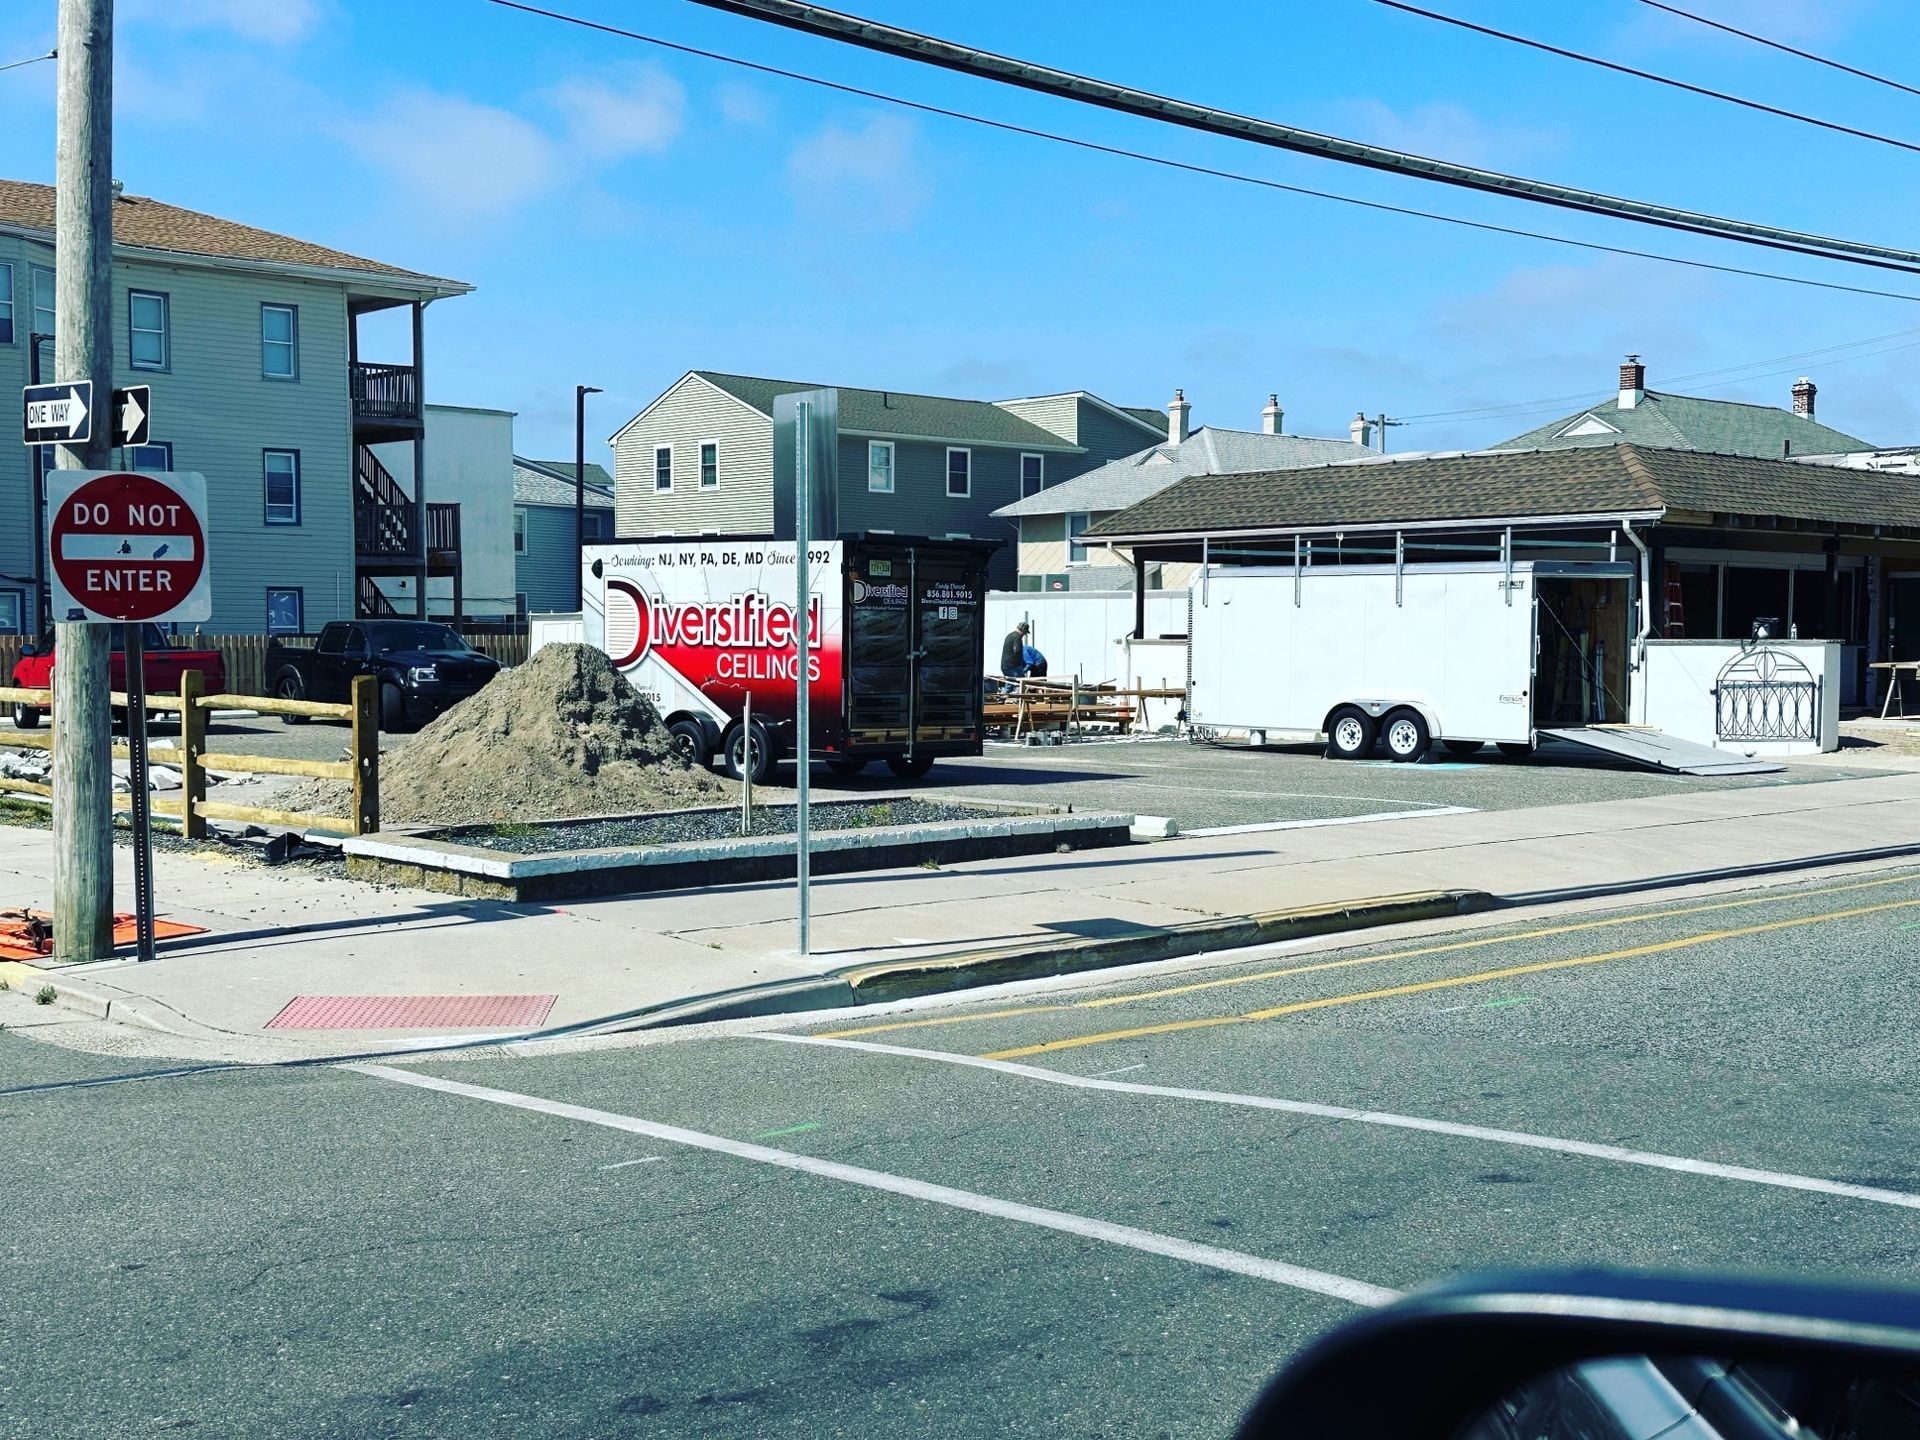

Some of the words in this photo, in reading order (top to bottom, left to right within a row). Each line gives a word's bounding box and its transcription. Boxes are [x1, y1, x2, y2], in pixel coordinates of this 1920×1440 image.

[29, 404, 46, 424] ONE
[51, 402, 70, 422] WAY
[74, 503, 110, 525] DO
[128, 504, 181, 527] NOT
[658, 553, 676, 567] NJ,
[679, 552, 697, 567] NY,
[701, 552, 718, 567] PA,
[722, 552, 741, 567] DE,
[745, 551, 763, 565] MD
[767, 550, 796, 566] Since
[807, 550, 830, 564] 992
[87, 569, 172, 592] ENTER
[607, 578, 819, 669] Diversified
